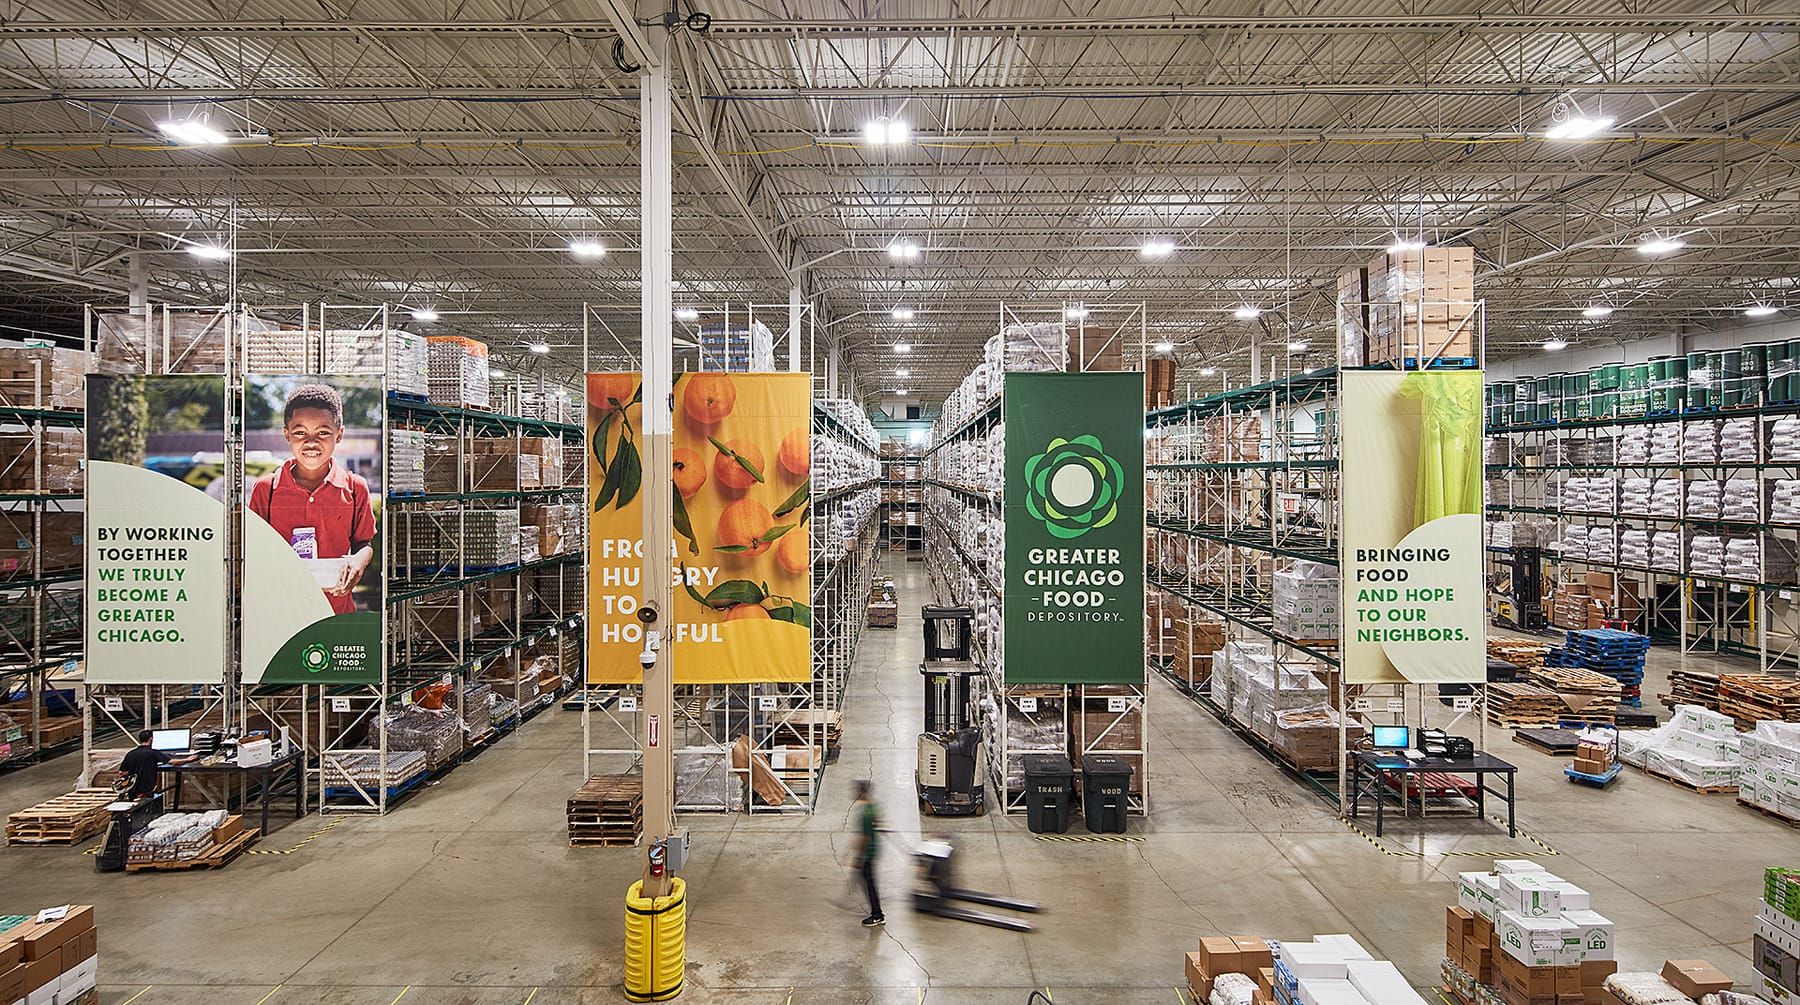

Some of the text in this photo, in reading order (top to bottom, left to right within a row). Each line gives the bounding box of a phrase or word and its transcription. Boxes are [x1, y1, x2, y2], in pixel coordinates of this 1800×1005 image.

[98, 528, 214, 541] BY WORKING
[97, 548, 188, 561] TOGETHER
[1028, 548, 1120, 565] GREATER
[1356, 548, 1451, 562] BRINGING
[98, 568, 186, 581] WE TRULY
[603, 567, 720, 587] HUGRY
[1024, 569, 1124, 586] CHICAGO
[1356, 569, 1409, 582] FOOD
[98, 589, 188, 602] BECOME A
[1043, 591, 1105, 607] FOOD
[1357, 588, 1455, 602] AND HOPE
[602, 595, 638, 615] TO
[97, 609, 175, 622] GREATER
[1357, 609, 1427, 622] TO OUR
[97, 629, 185, 643] CHICAGO.
[602, 623, 724, 643] HOFUL
[1357, 628, 1470, 642] NEIGHBORS.
[1506, 932, 1521, 949] LED
[1587, 940, 1606, 950] LED
